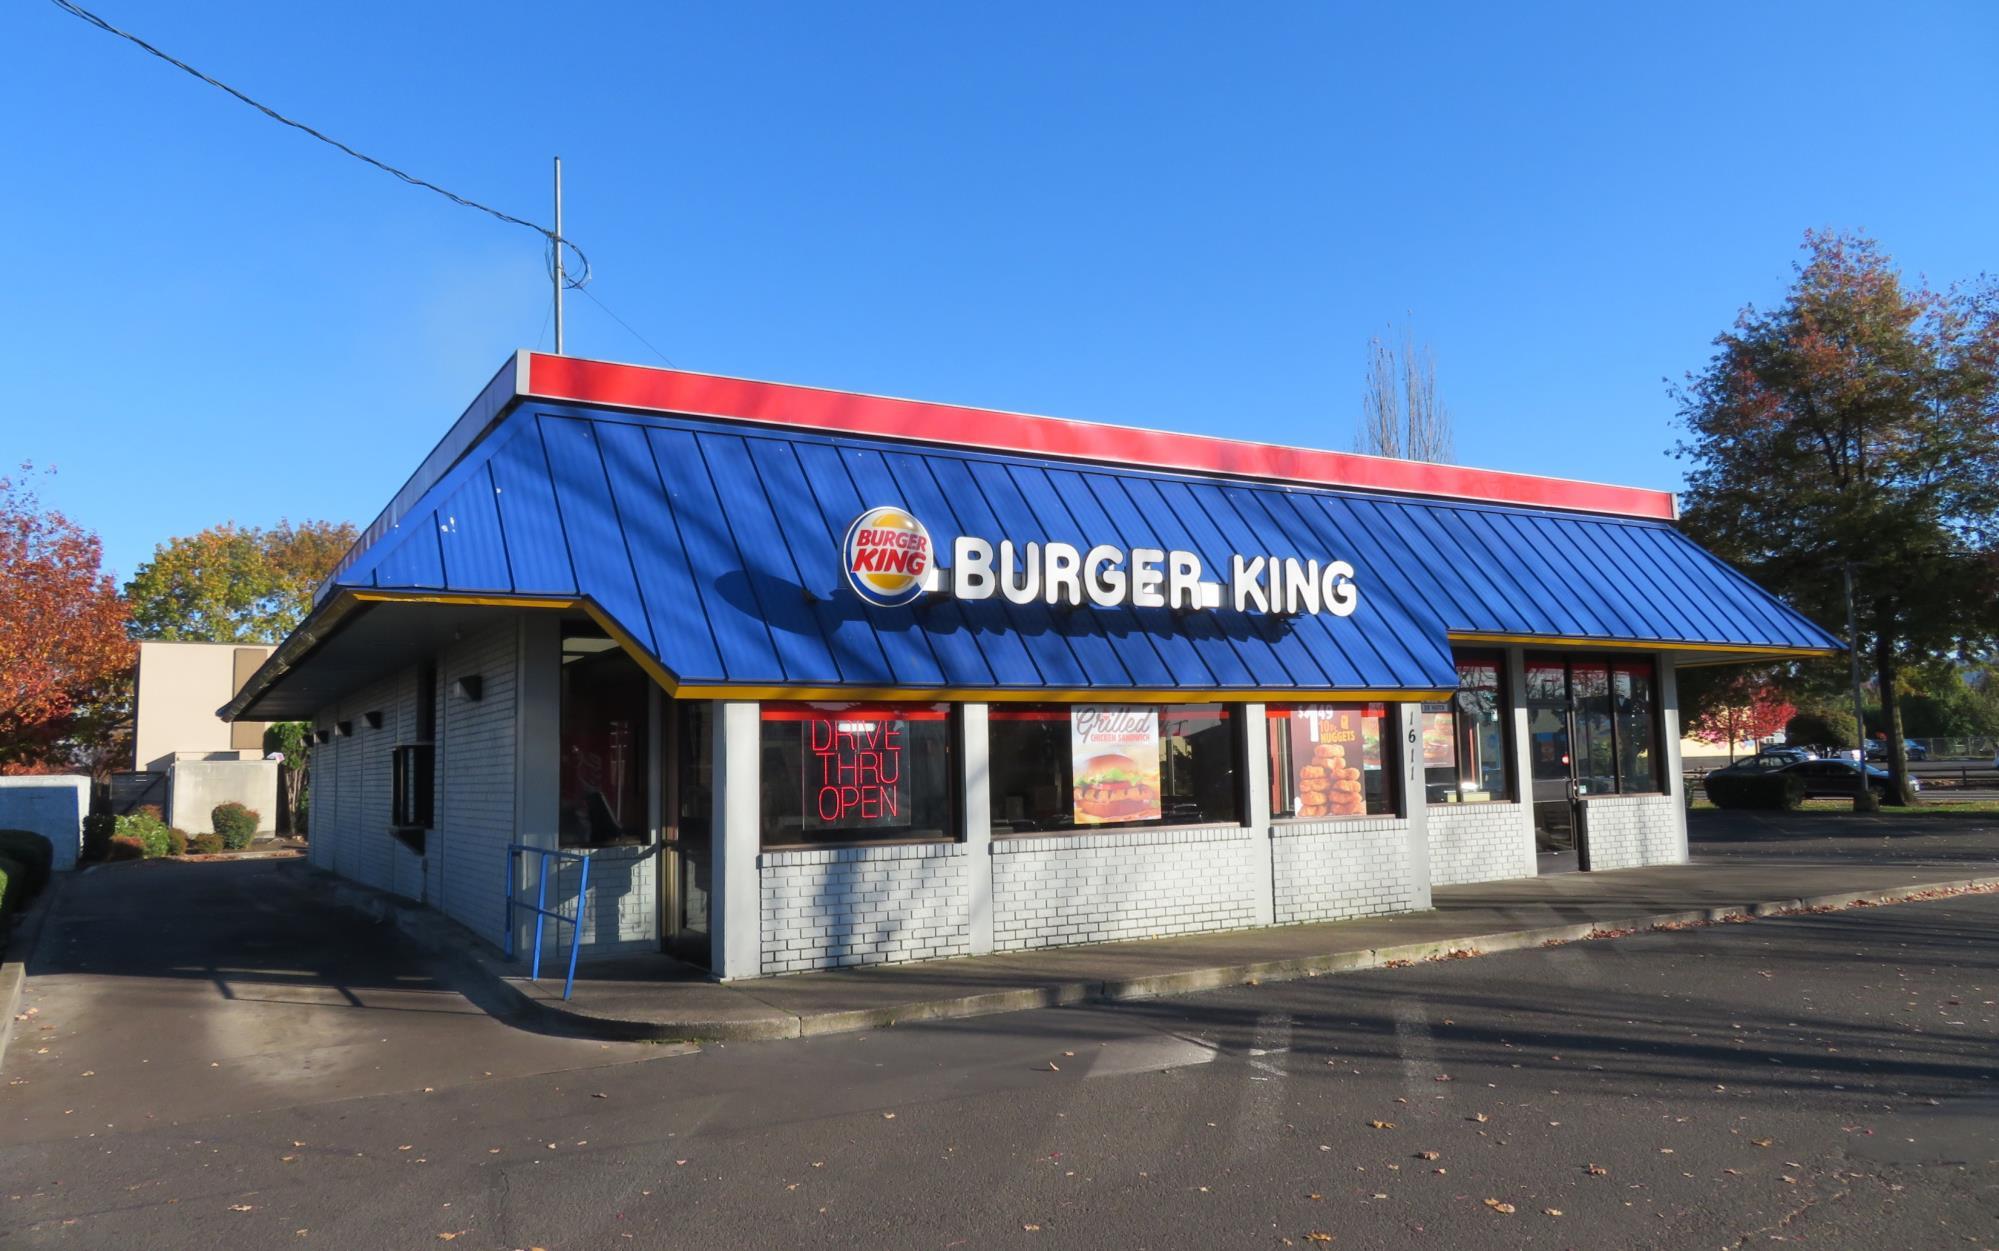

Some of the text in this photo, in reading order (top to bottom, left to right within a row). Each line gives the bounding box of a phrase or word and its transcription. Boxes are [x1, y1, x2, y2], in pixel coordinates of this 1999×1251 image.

[856, 529, 928, 553] BURGER
[852, 547, 927, 576] KING
[954, 536, 1358, 617] BURGER KING
[811, 719, 902, 753] DRIVE
[1076, 707, 1150, 744] Grilled
[1320, 730, 1356, 744] NUGGETS
[815, 751, 900, 786] THRU
[818, 785, 898, 821] OPEN
